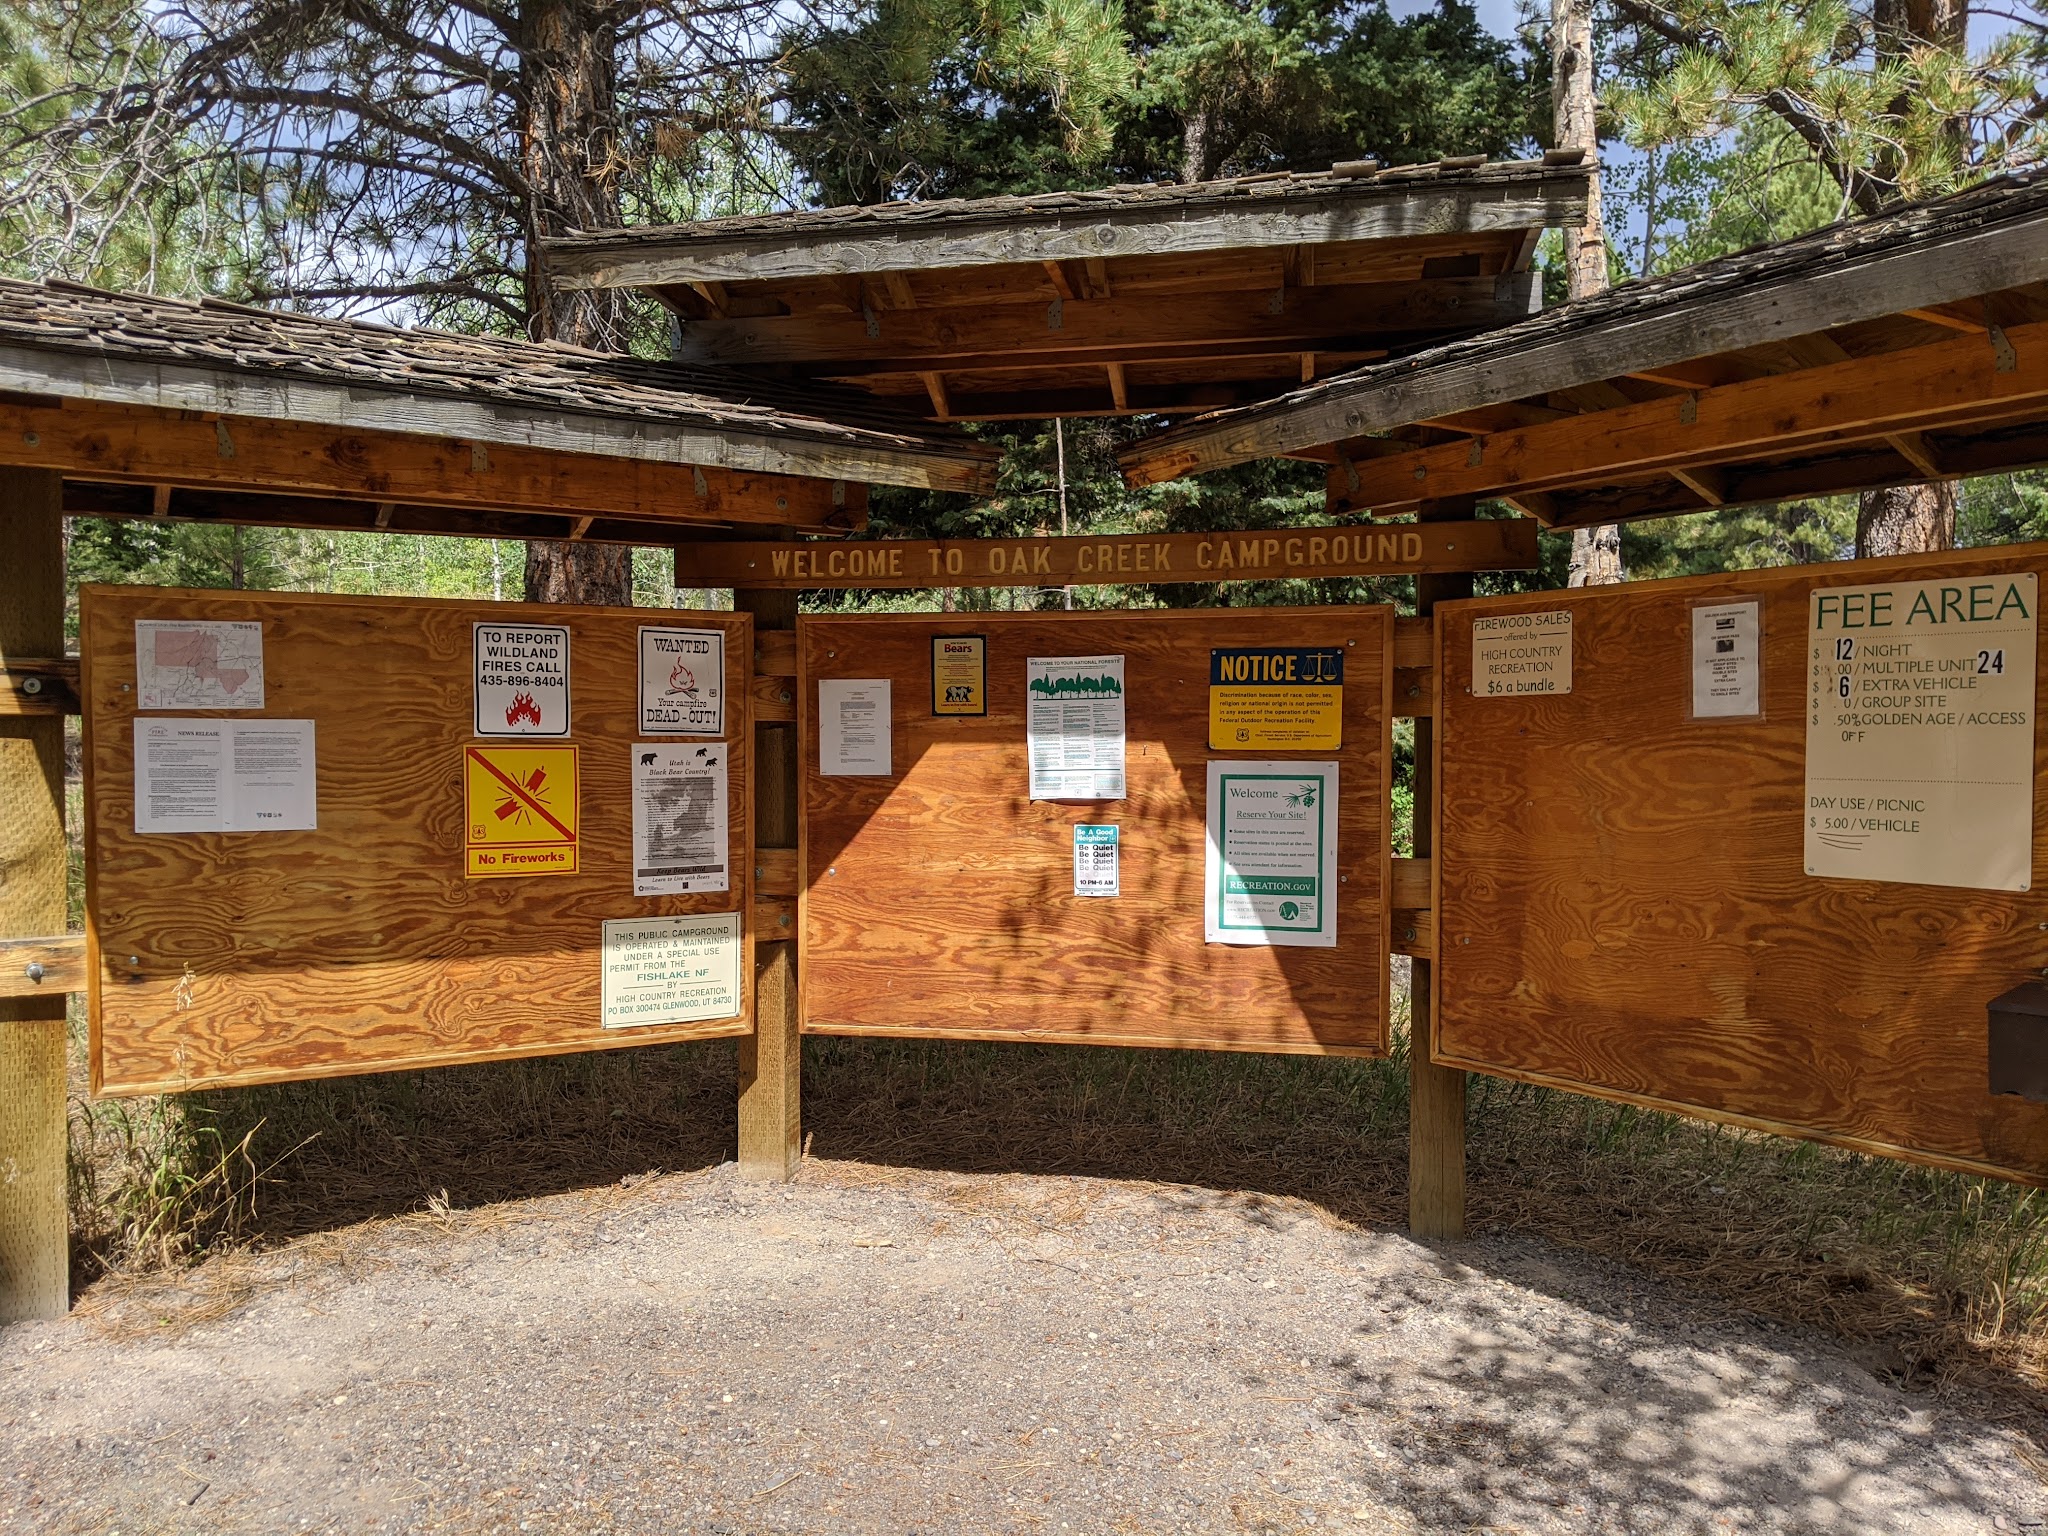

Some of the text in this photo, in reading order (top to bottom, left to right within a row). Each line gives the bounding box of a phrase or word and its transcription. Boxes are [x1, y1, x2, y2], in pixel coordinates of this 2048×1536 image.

[772, 532, 1422, 578] WELCOME TO OAK CREEK CAMPGROUND
[1816, 582, 2030, 630] FEE AREA
[1474, 612, 1571, 631] FIREWOOD SALES
[483, 632, 561, 644] TO REPORT
[1504, 632, 1538, 641] offered by
[486, 646, 558, 658] WILDLAND
[654, 638, 710, 654] WANTED
[944, 644, 972, 653] Bears
[1481, 646, 1562, 660] HIGH COUNTRY
[1836, 638, 1853, 660] 12
[482, 660, 561, 672] FIRES CALL
[1220, 654, 1298, 681] NOTICE
[1488, 662, 1553, 674] RECREATION
[1862, 650, 2004, 675] MULTIPLE UNIT 24
[480, 674, 564, 687] 435-896-8404
[1487, 678, 1555, 695] $6 a bundle
[1840, 676, 1978, 698] 6 EXTRA VEHICLE
[657, 698, 707, 709] Your campfire
[1862, 695, 1947, 709] GROUP SITE
[646, 709, 716, 724] DEAD OUT!
[1862, 713, 1922, 726] GOLDEN
[1925, 712, 1956, 725] AGE
[1966, 711, 2026, 725] ACCESS
[1841, 730, 1866, 742] OFF
[1230, 788, 1279, 798] Welcome
[1810, 796, 1926, 812] DAY USE PICNIC
[1236, 810, 1306, 819] Reserve Your Site!
[1824, 817, 1849, 829] 5.00
[1859, 818, 1920, 833] VEHICLE
[478, 852, 565, 865] No Fireworks
[656, 866, 672, 875] Keep
[673, 866, 690, 874] Bears
[1230, 880, 1311, 890] RECREATION.GOV
[615, 926, 729, 941] THIS PUBLIC CAMPGROUND
[612, 944, 621, 952] IS
[625, 941, 669, 951] OPERATED
[682, 936, 730, 947] MAINTAINED
[623, 947, 720, 962] UNDER A SPECIAL USE
[609, 960, 686, 973] PERMIT FROM THE
[637, 968, 710, 982] FISHLAKE NF
[667, 981, 678, 989] BY
[616, 987, 727, 1004] HIGH COUNTRY RECREATION
[608, 996, 732, 1015] PO BOX 300474 GLENWOOD, UT 84730
